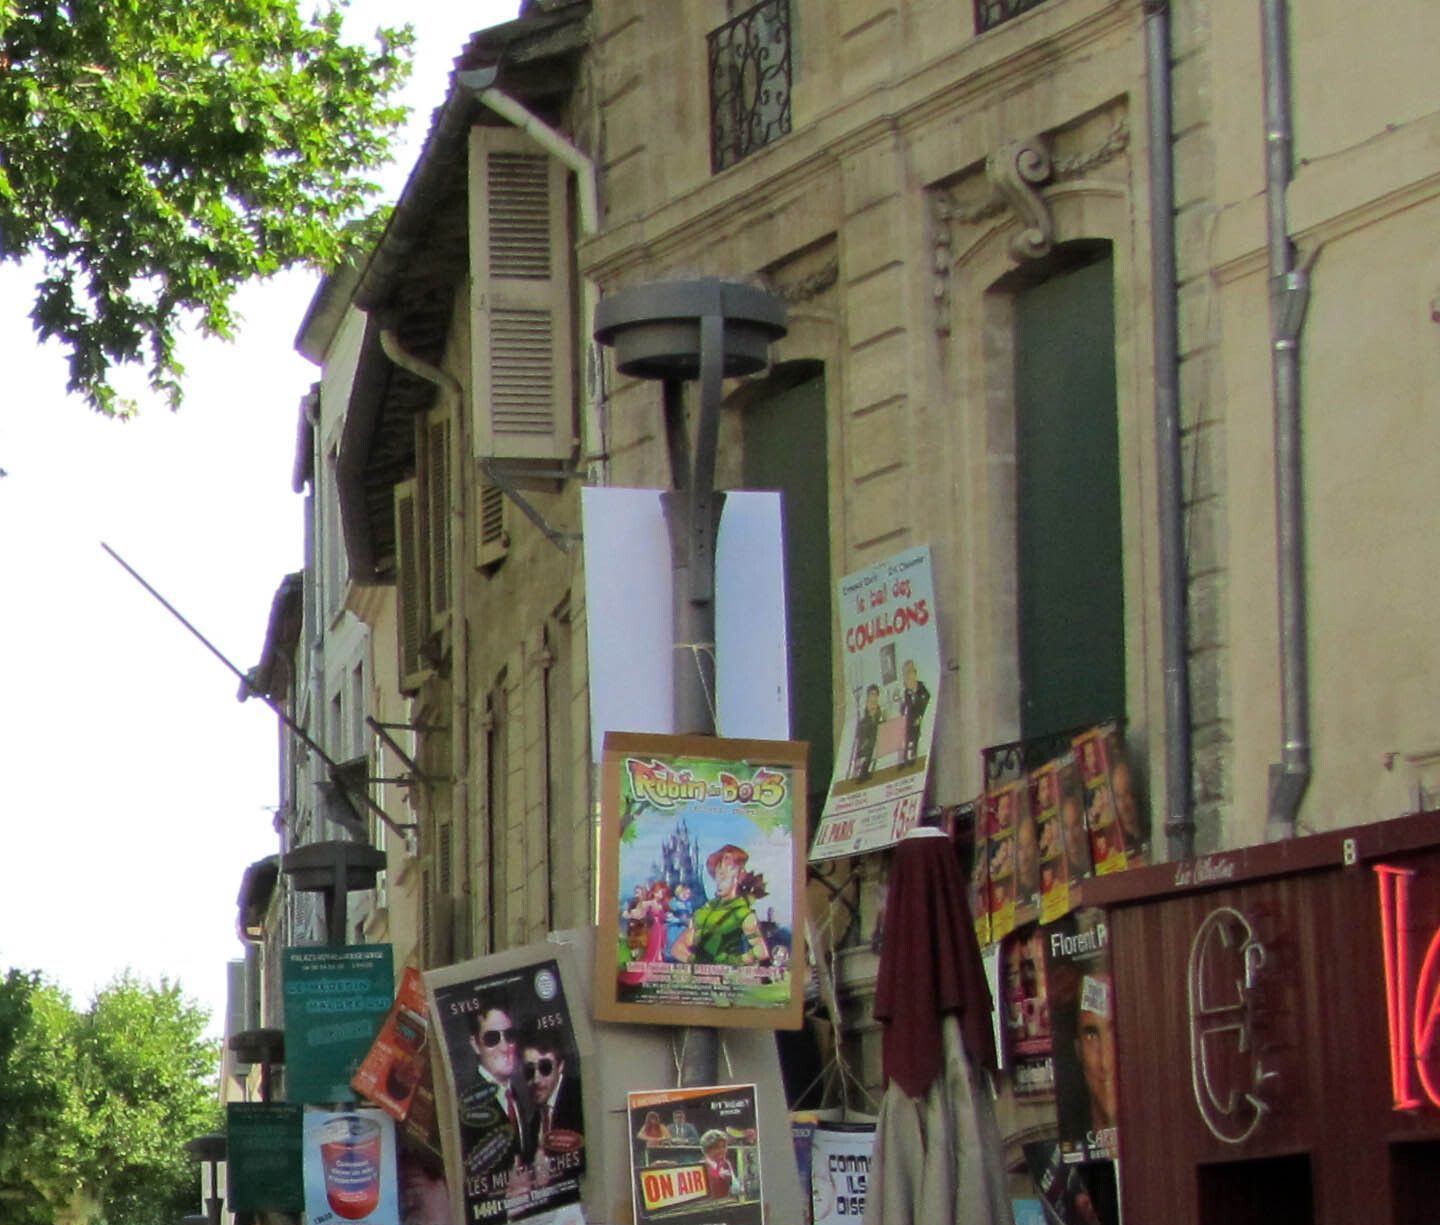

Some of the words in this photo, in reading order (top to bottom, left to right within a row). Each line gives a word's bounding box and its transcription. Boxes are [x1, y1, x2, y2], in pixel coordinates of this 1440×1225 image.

[1051, 930, 1097, 958] Florent
[829, 1153, 871, 1173] COMM
[644, 1172, 676, 1204] ON
[676, 1166, 706, 1198] AIR
